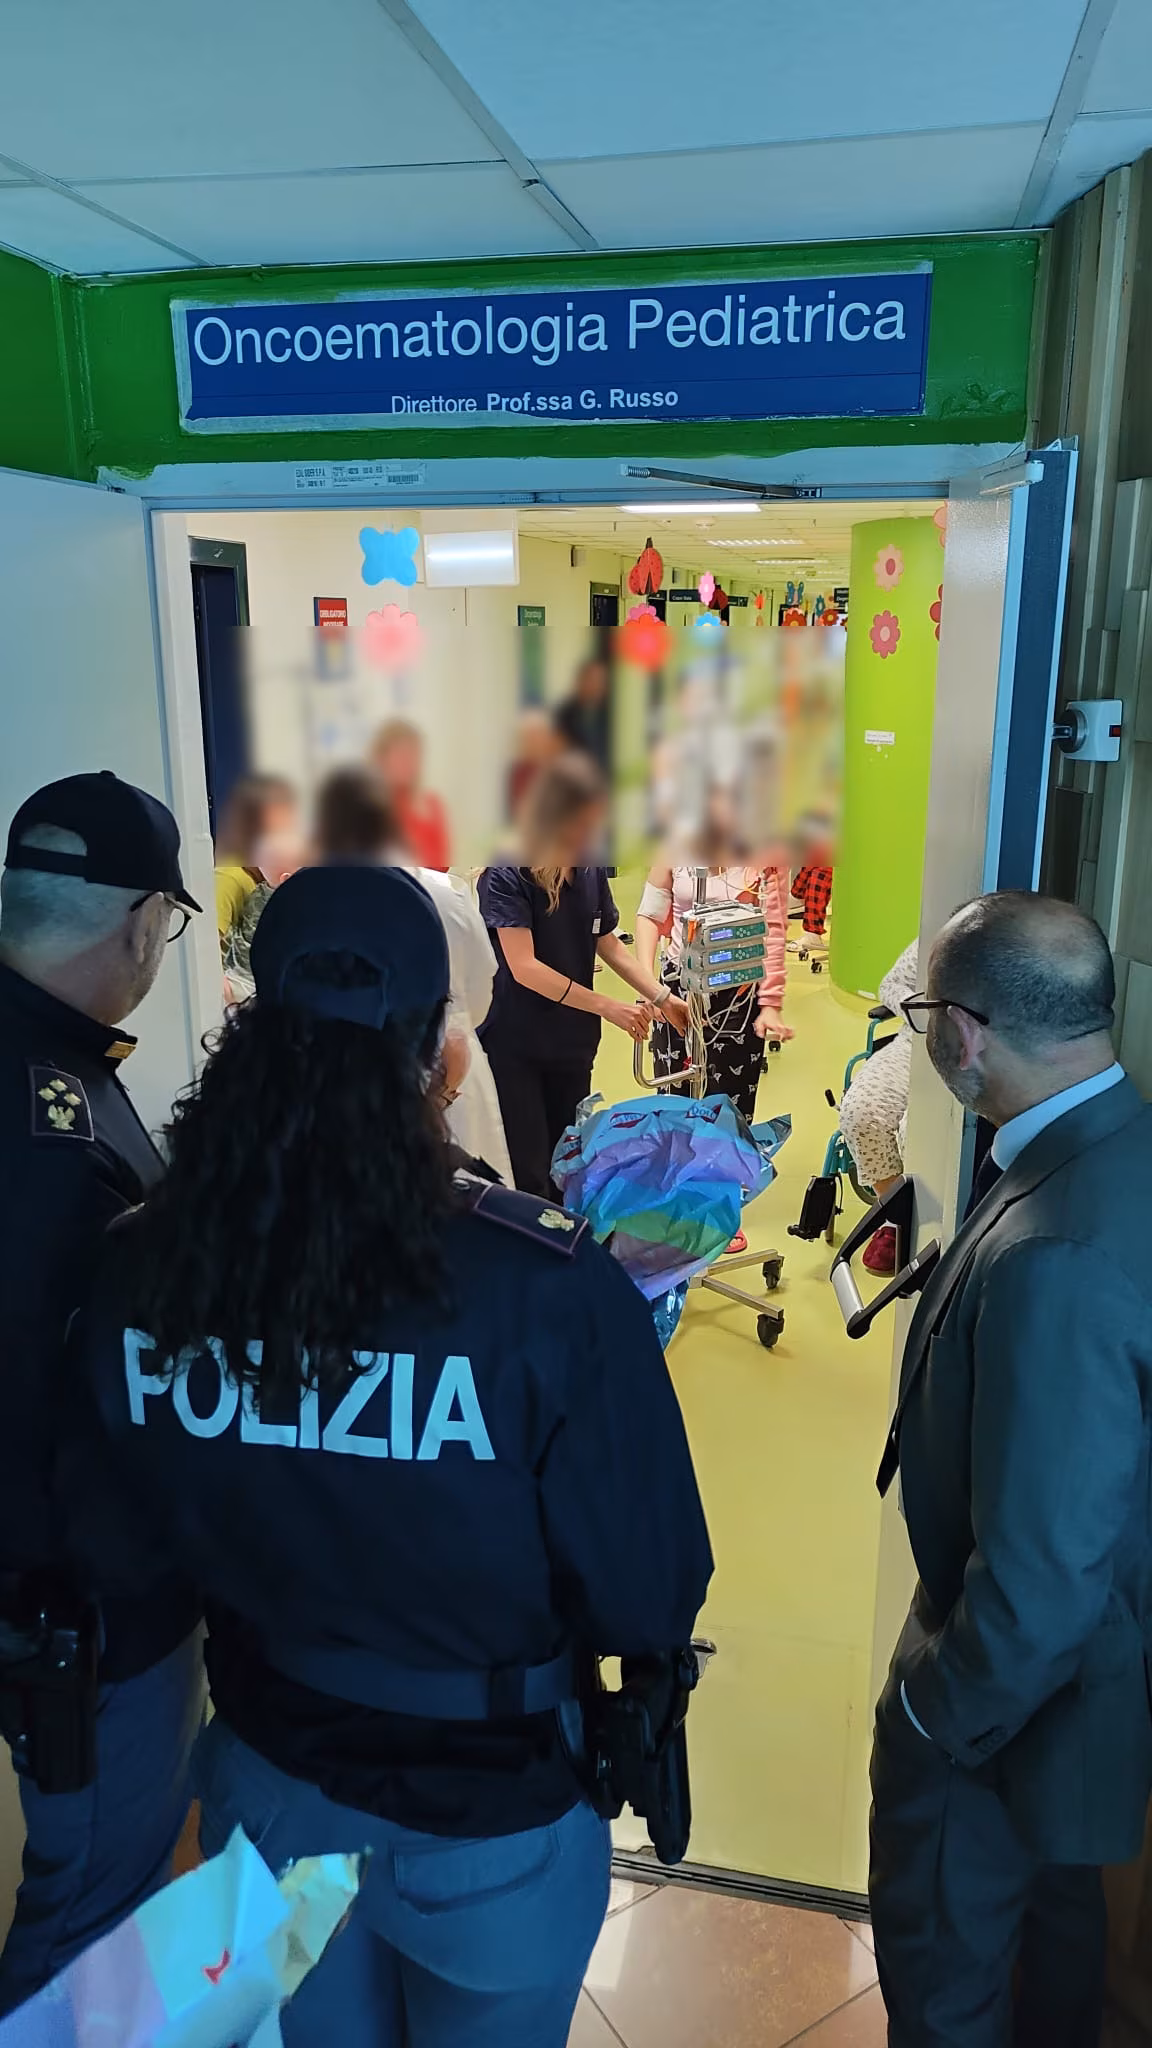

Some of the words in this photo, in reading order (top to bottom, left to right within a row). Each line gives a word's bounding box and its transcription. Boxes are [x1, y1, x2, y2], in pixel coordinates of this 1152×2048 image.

[194, 302, 608, 366] Oncoematologia
[628, 290, 906, 349] Pediatrica
[391, 395, 478, 414] Direttore
[487, 391, 573, 412] Prof.ssa
[580, 389, 603, 410] G.
[609, 388, 679, 408] Russo
[123, 1327, 496, 1461] POLIZIA
